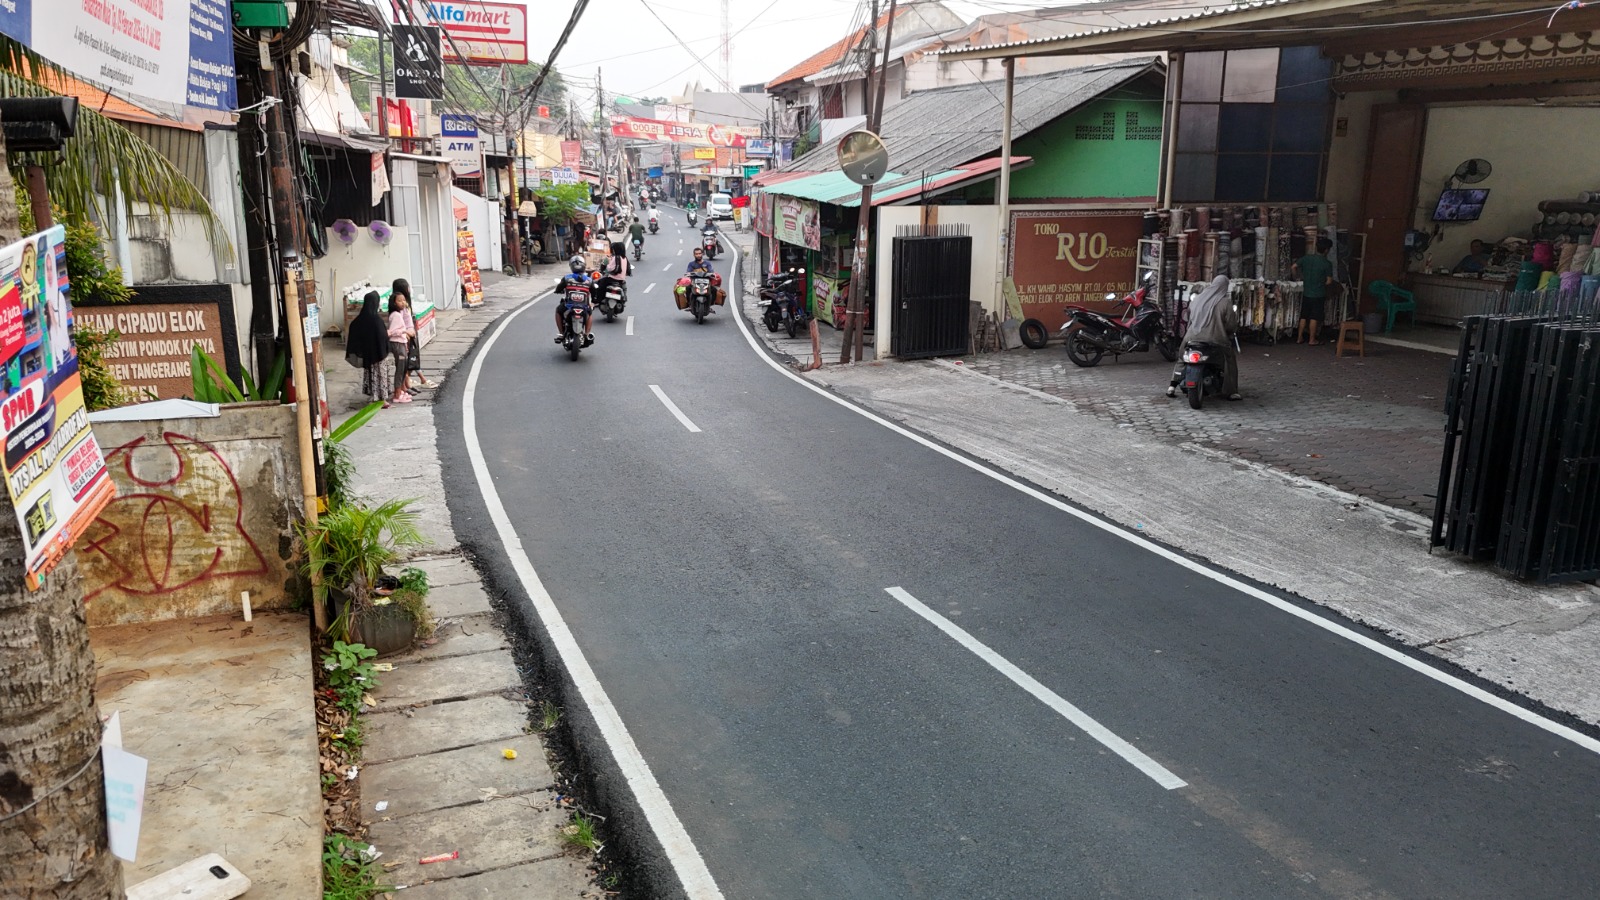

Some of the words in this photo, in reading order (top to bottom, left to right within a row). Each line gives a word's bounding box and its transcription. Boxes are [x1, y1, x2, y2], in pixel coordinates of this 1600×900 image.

[426, 3, 510, 25] Alfamart
[448, 142, 474, 152] ATM
[554, 171, 577, 180] DIJUAL
[1034, 223, 1059, 236] TOKO
[1055, 232, 1108, 269] RIO
[118, 312, 167, 335] CIPADU
[169, 310, 206, 334] ELOK
[140, 339, 181, 358] PONDOK
[131, 361, 192, 380] TANGERANG
[2, 387, 35, 432] SPMB
[28, 453, 43, 483] AL
[84, 467, 97, 481] FULL
